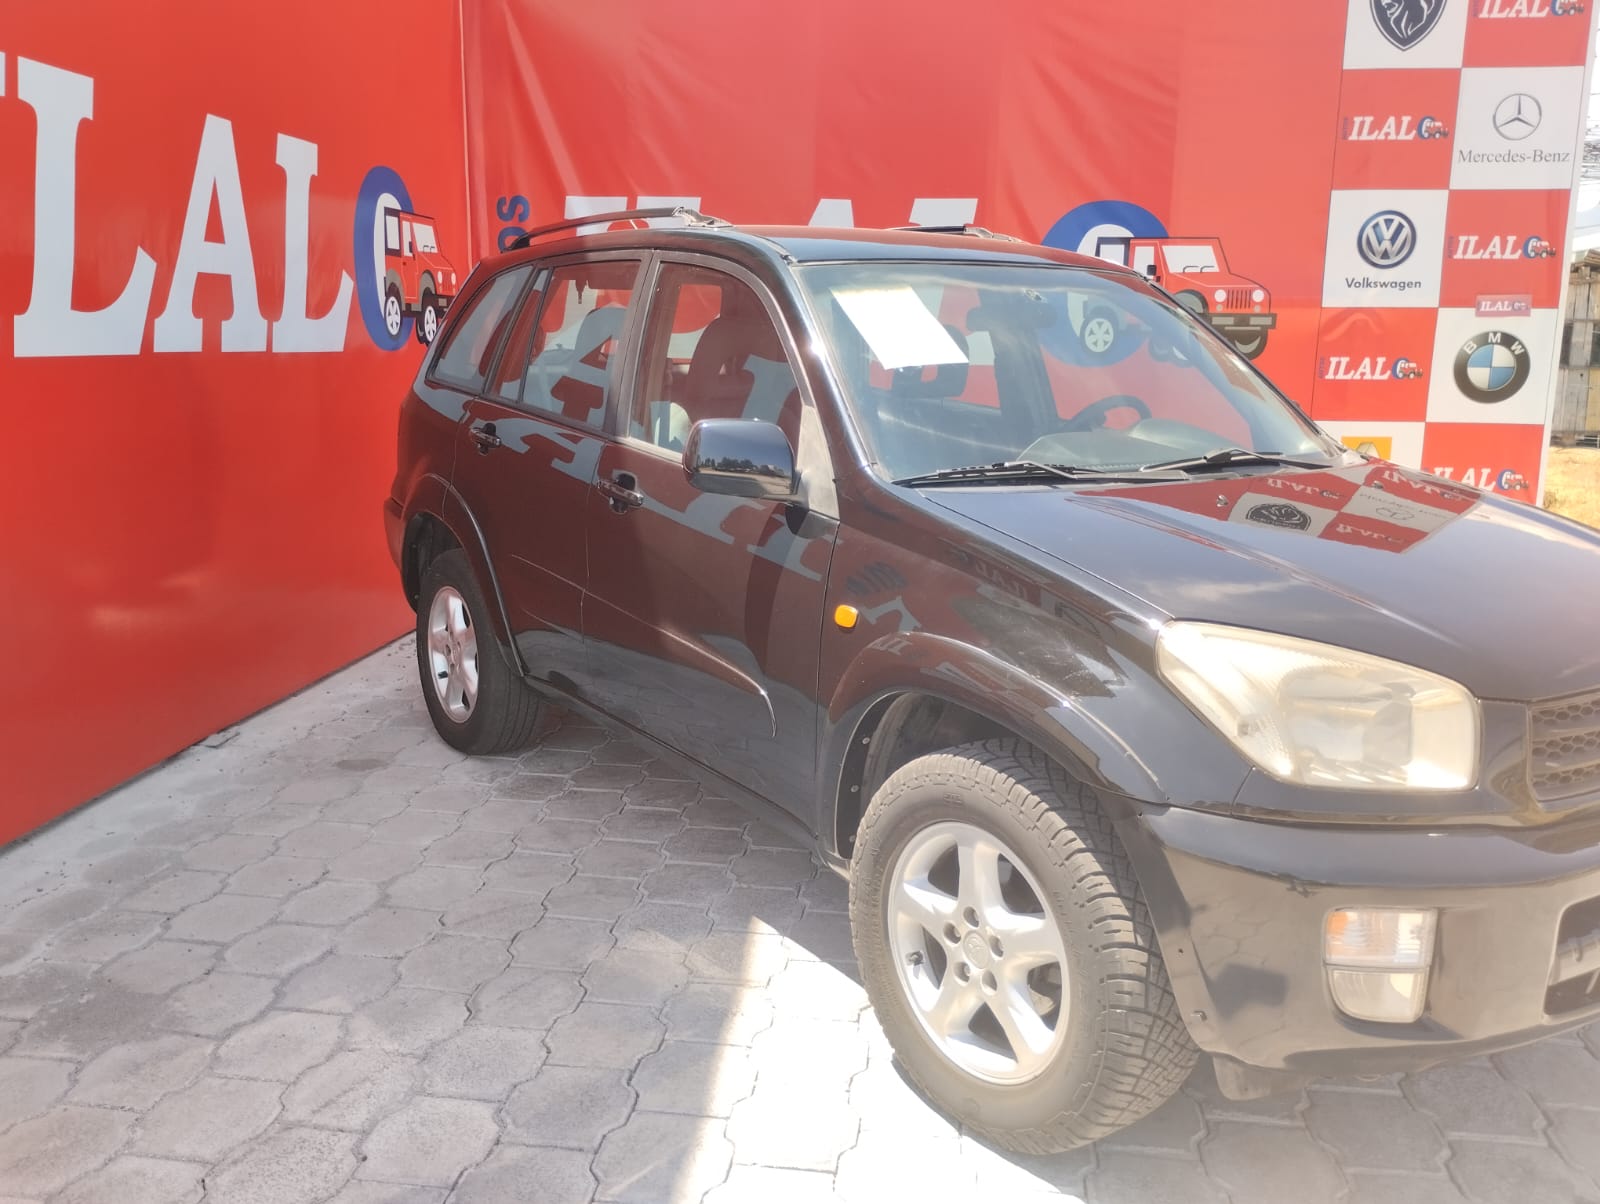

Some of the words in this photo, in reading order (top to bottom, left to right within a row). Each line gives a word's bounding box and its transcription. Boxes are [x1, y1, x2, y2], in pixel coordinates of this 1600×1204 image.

[1348, 116, 1415, 141] ILAL
[1457, 149, 1570, 164] Mercedes-Benz
[0, 51, 355, 358] LAL
[1453, 235, 1522, 259] ILAL
[1345, 277, 1422, 291] Volkswagen
[1479, 300, 1513, 312] ILAL
[1463, 331, 1525, 355] BMW
[1324, 357, 1391, 381] ILAL
